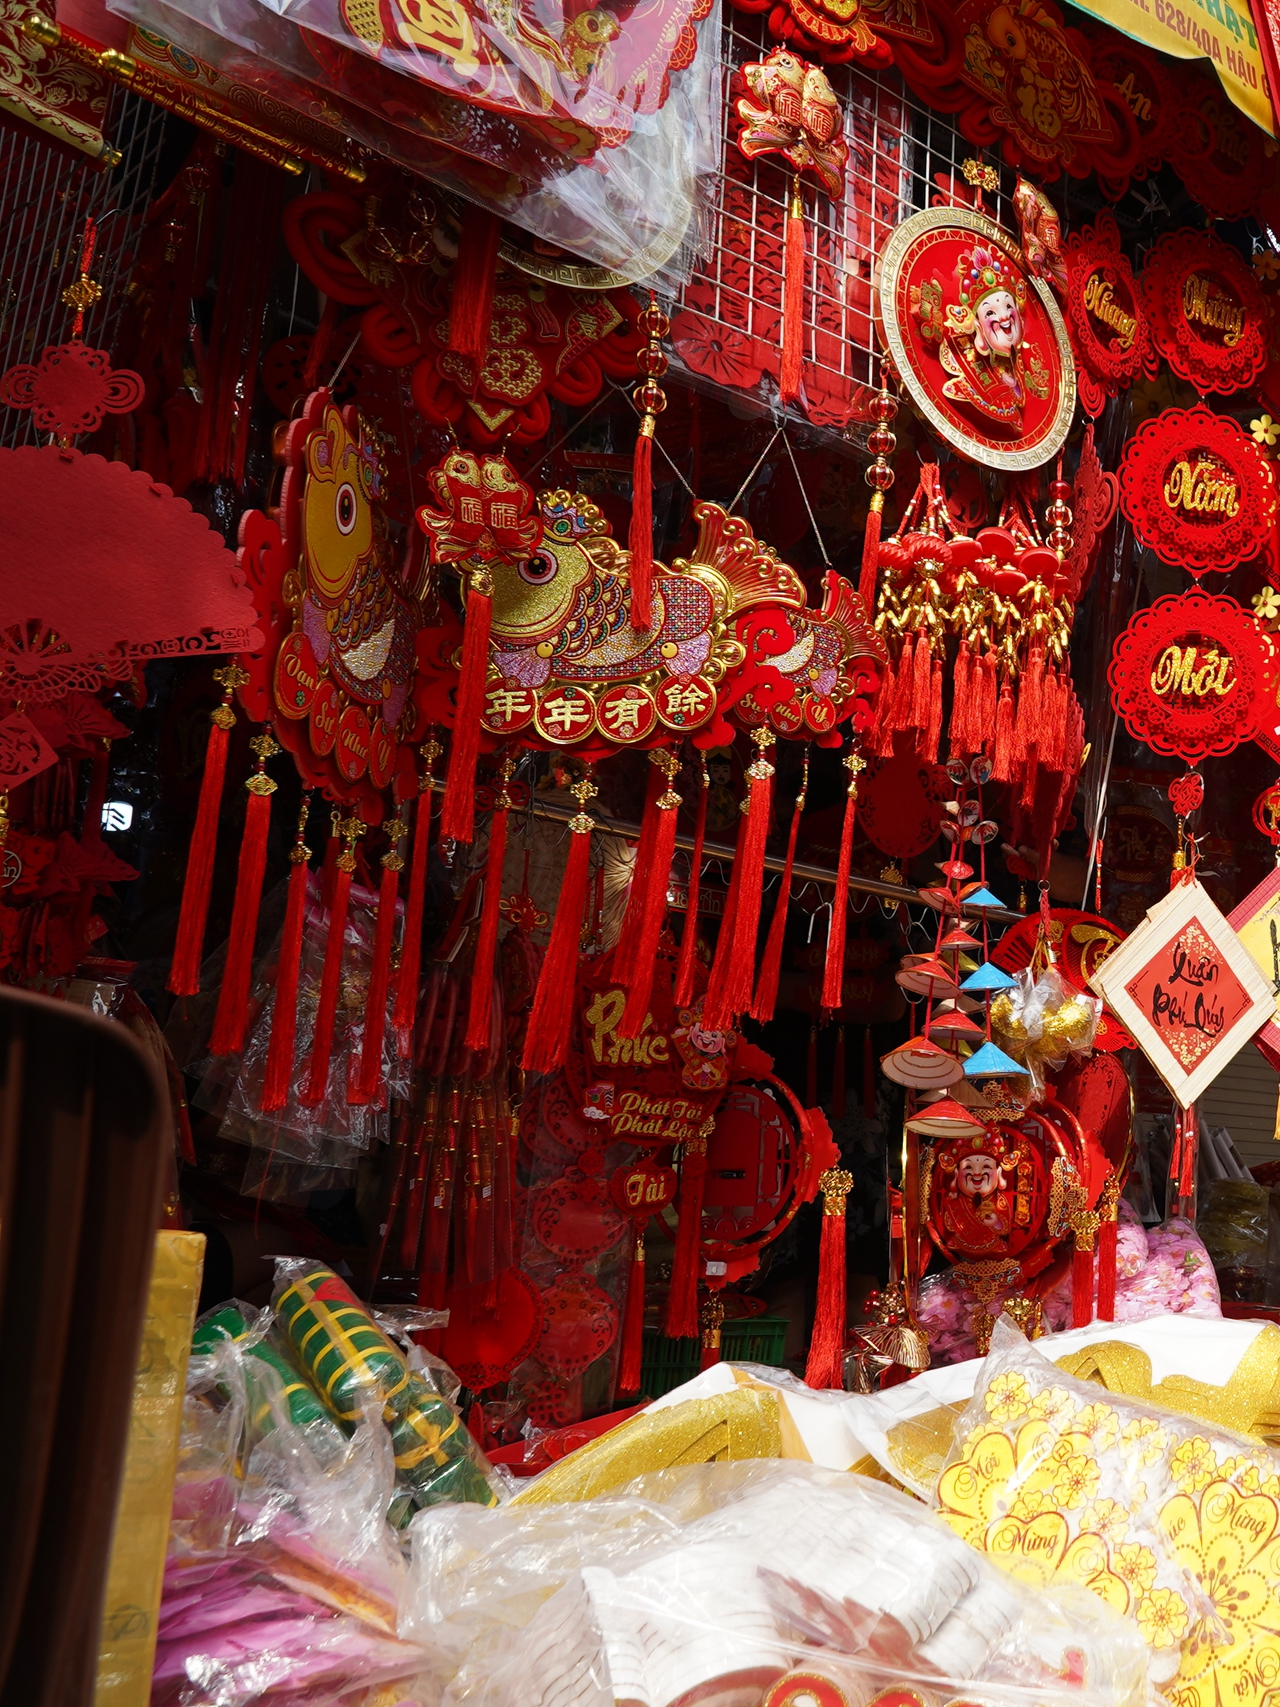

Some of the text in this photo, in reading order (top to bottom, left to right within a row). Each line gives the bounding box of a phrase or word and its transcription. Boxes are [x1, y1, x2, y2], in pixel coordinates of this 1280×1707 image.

[1226, 46, 1258, 90] HẬU
[1163, 460, 1240, 519] Năm
[491, 502, 518, 530] 福
[1150, 645, 1238, 697] Mới
[485, 684, 708, 732] 年年有餘
[611, 1113, 662, 1135] Phát
[619, 1093, 703, 1120] Phát Tài
[626, 1173, 667, 1206] Tài
[1206, 1492, 1267, 1543] Mừng
[992, 1525, 1059, 1560] Mừng
